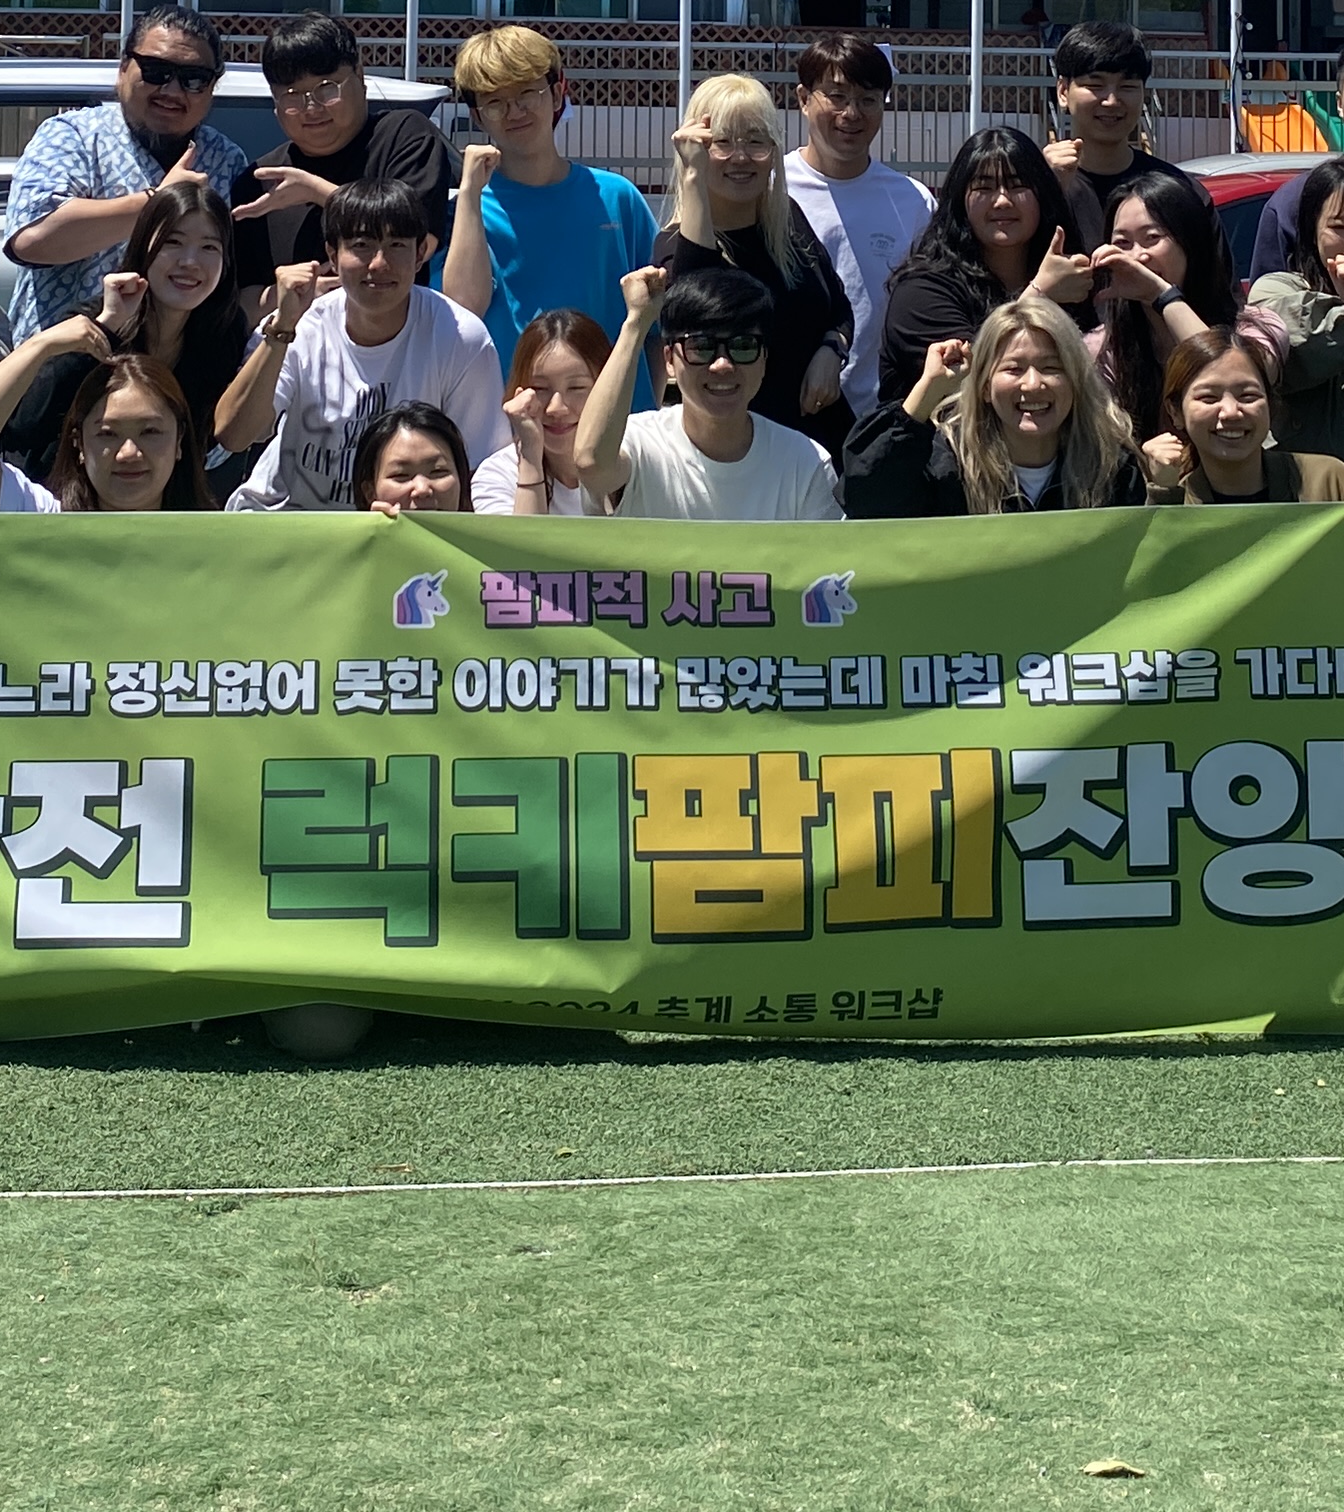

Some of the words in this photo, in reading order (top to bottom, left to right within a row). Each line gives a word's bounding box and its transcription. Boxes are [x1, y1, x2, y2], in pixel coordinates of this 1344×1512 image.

[480, 569, 648, 629] 팜피적
[661, 570, 776, 629] 사고
[105, 658, 322, 718] 정신없어
[333, 656, 443, 716] 못한
[453, 655, 662, 713] 이야기가
[675, 655, 889, 714] 많았는데
[899, 650, 1007, 710] 마침
[1016, 648, 1223, 707] 워크샵을
[743, 993, 818, 1024] 소통
[830, 987, 944, 1022] 워크샵
